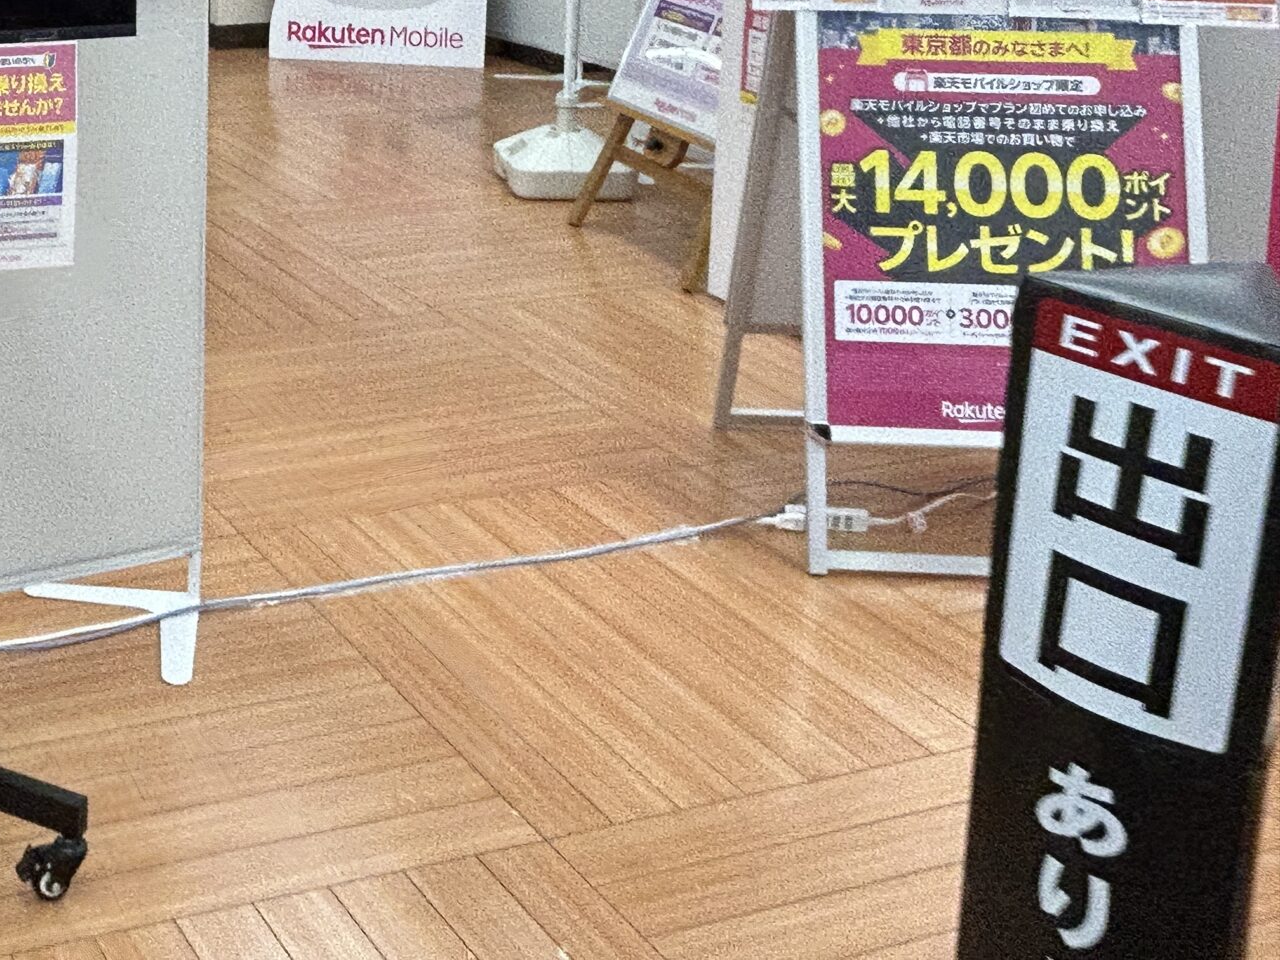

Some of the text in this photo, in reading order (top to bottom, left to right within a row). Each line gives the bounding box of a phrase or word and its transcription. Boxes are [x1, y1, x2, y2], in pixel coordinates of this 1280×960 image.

[287, 21, 464, 50] Rakuten Mobile
[901, 33, 1090, 58] 東京都のみなさまへ!
[933, 76, 1084, 93] 楽天モバイルショップ限定
[859, 148, 1121, 221] 14,000
[869, 222, 1135, 274] プレゼント!
[958, 307, 1012, 329] 3,00
[1058, 312, 1257, 401] EXIT
[941, 400, 1005, 423] Rakute
[1037, 394, 1214, 720] 出口
[1035, 762, 1129, 960] あり
